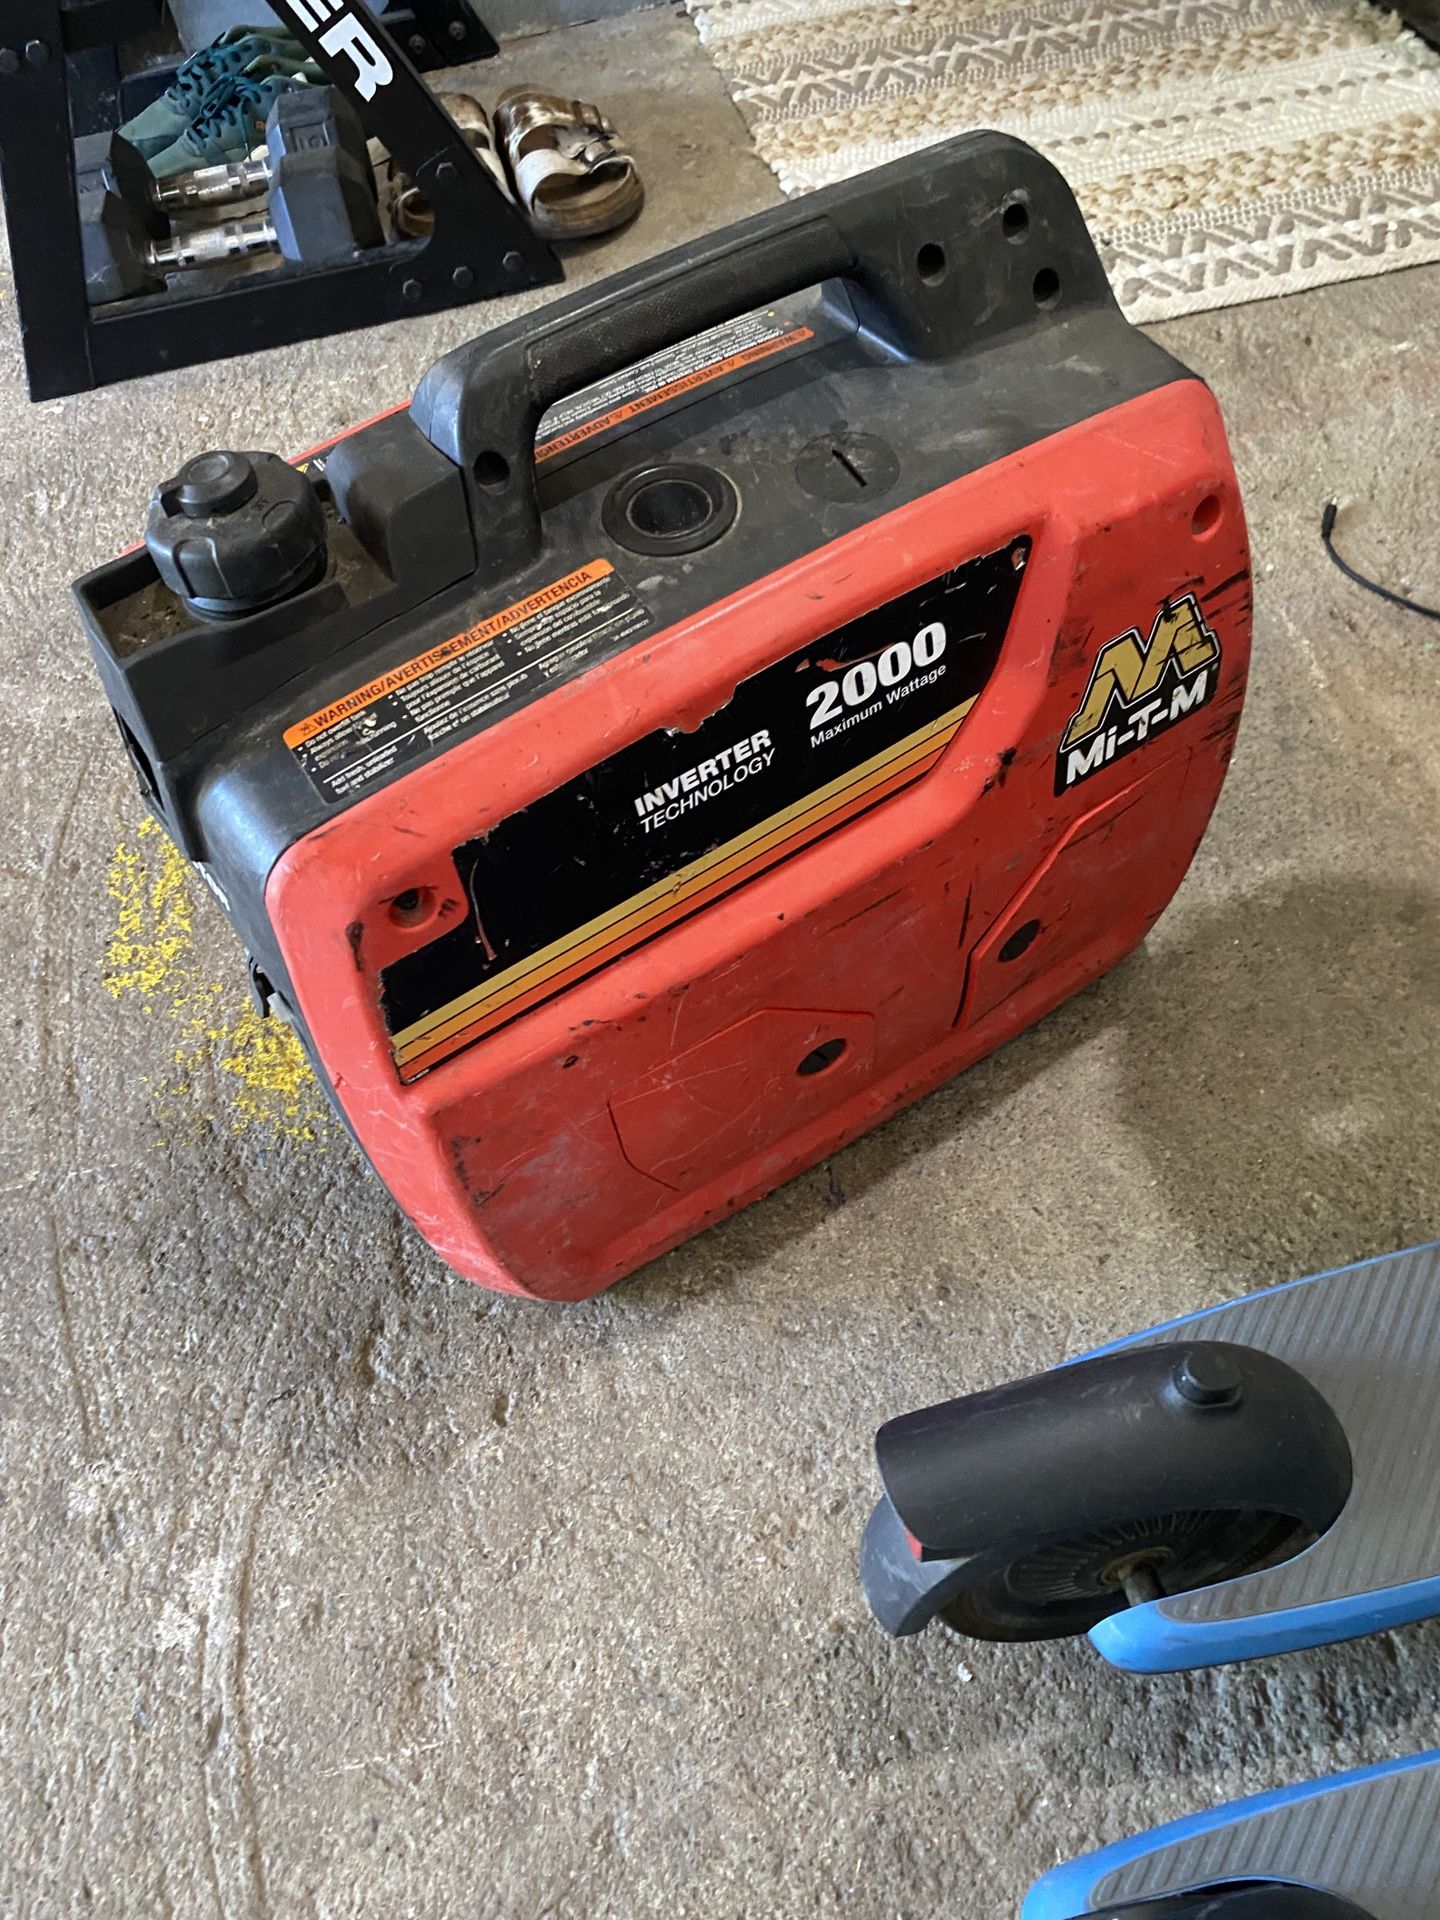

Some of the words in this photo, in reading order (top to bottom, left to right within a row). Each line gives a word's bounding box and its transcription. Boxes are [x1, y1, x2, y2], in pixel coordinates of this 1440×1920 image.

[629, 366, 723, 413] AVERTISSEMENT
[535, 415, 612, 458] ADVERTENCI
[806, 622, 946, 730] 2000
[811, 700, 883, 748] Maximum
[886, 664, 947, 704] Wattage
[1066, 669, 1208, 784] Mi-T-M
[634, 729, 772, 817] INVERTER
[640, 748, 775, 834] TECHNOLOGY
